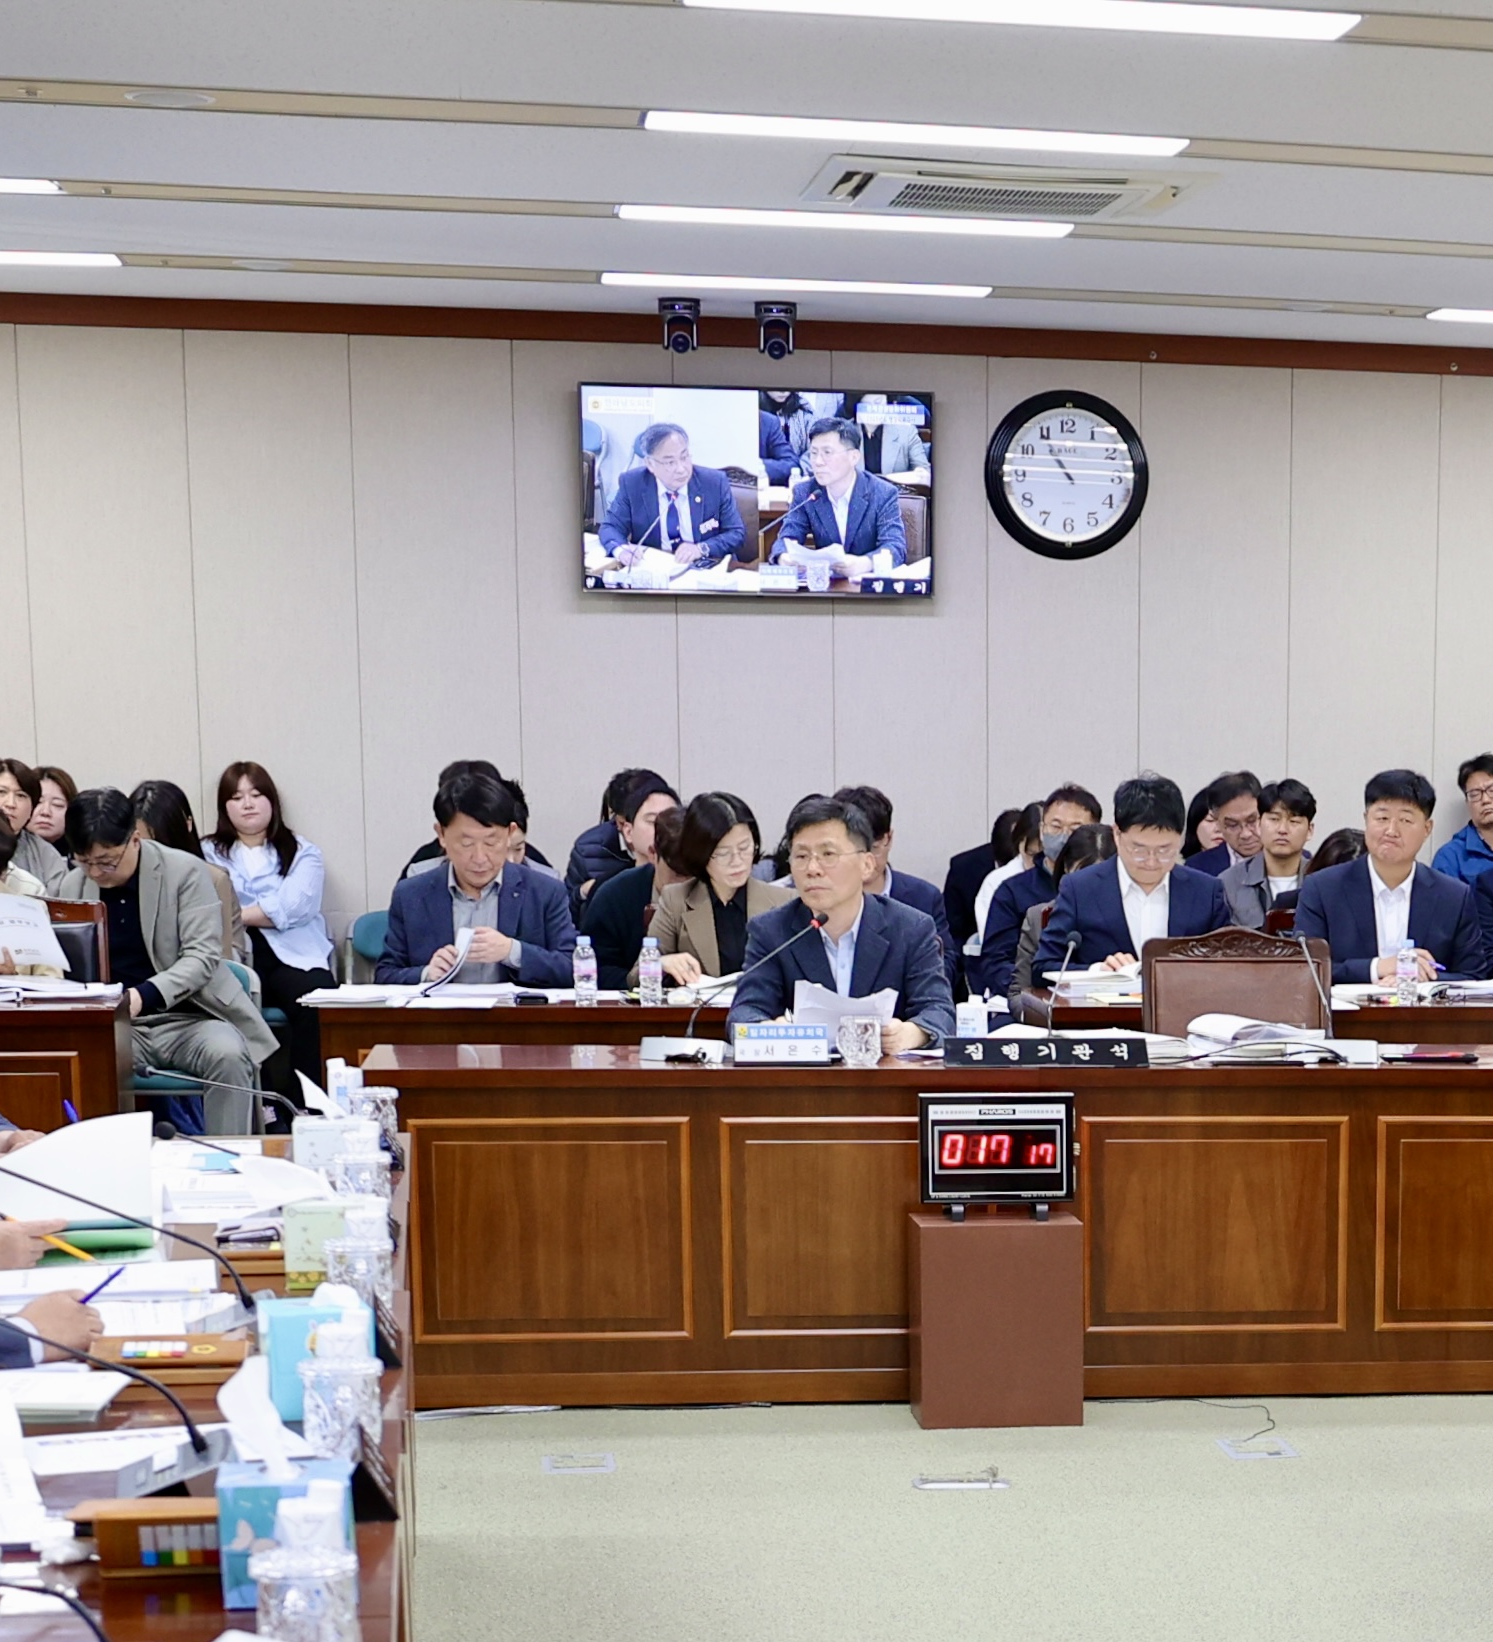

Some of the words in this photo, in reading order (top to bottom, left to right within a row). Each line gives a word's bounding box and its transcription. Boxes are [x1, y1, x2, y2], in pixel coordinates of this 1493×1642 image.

[1060, 418, 1076, 434] 12
[1021, 443, 1035, 459] 10
[1104, 447, 1117, 461] 2
[1014, 467, 1026, 483] 9
[1110, 470, 1123, 485] 3
[1021, 492, 1034, 508] 8
[1101, 493, 1114, 509] 4
[1039, 510, 1051, 526] 7
[1063, 517, 1075, 534] 6
[1087, 511, 1099, 527] 5
[964, 1041, 1130, 1062] 집행기관석
[941, 1134, 1011, 1165] 017
[1029, 1143, 1054, 1165] 17
